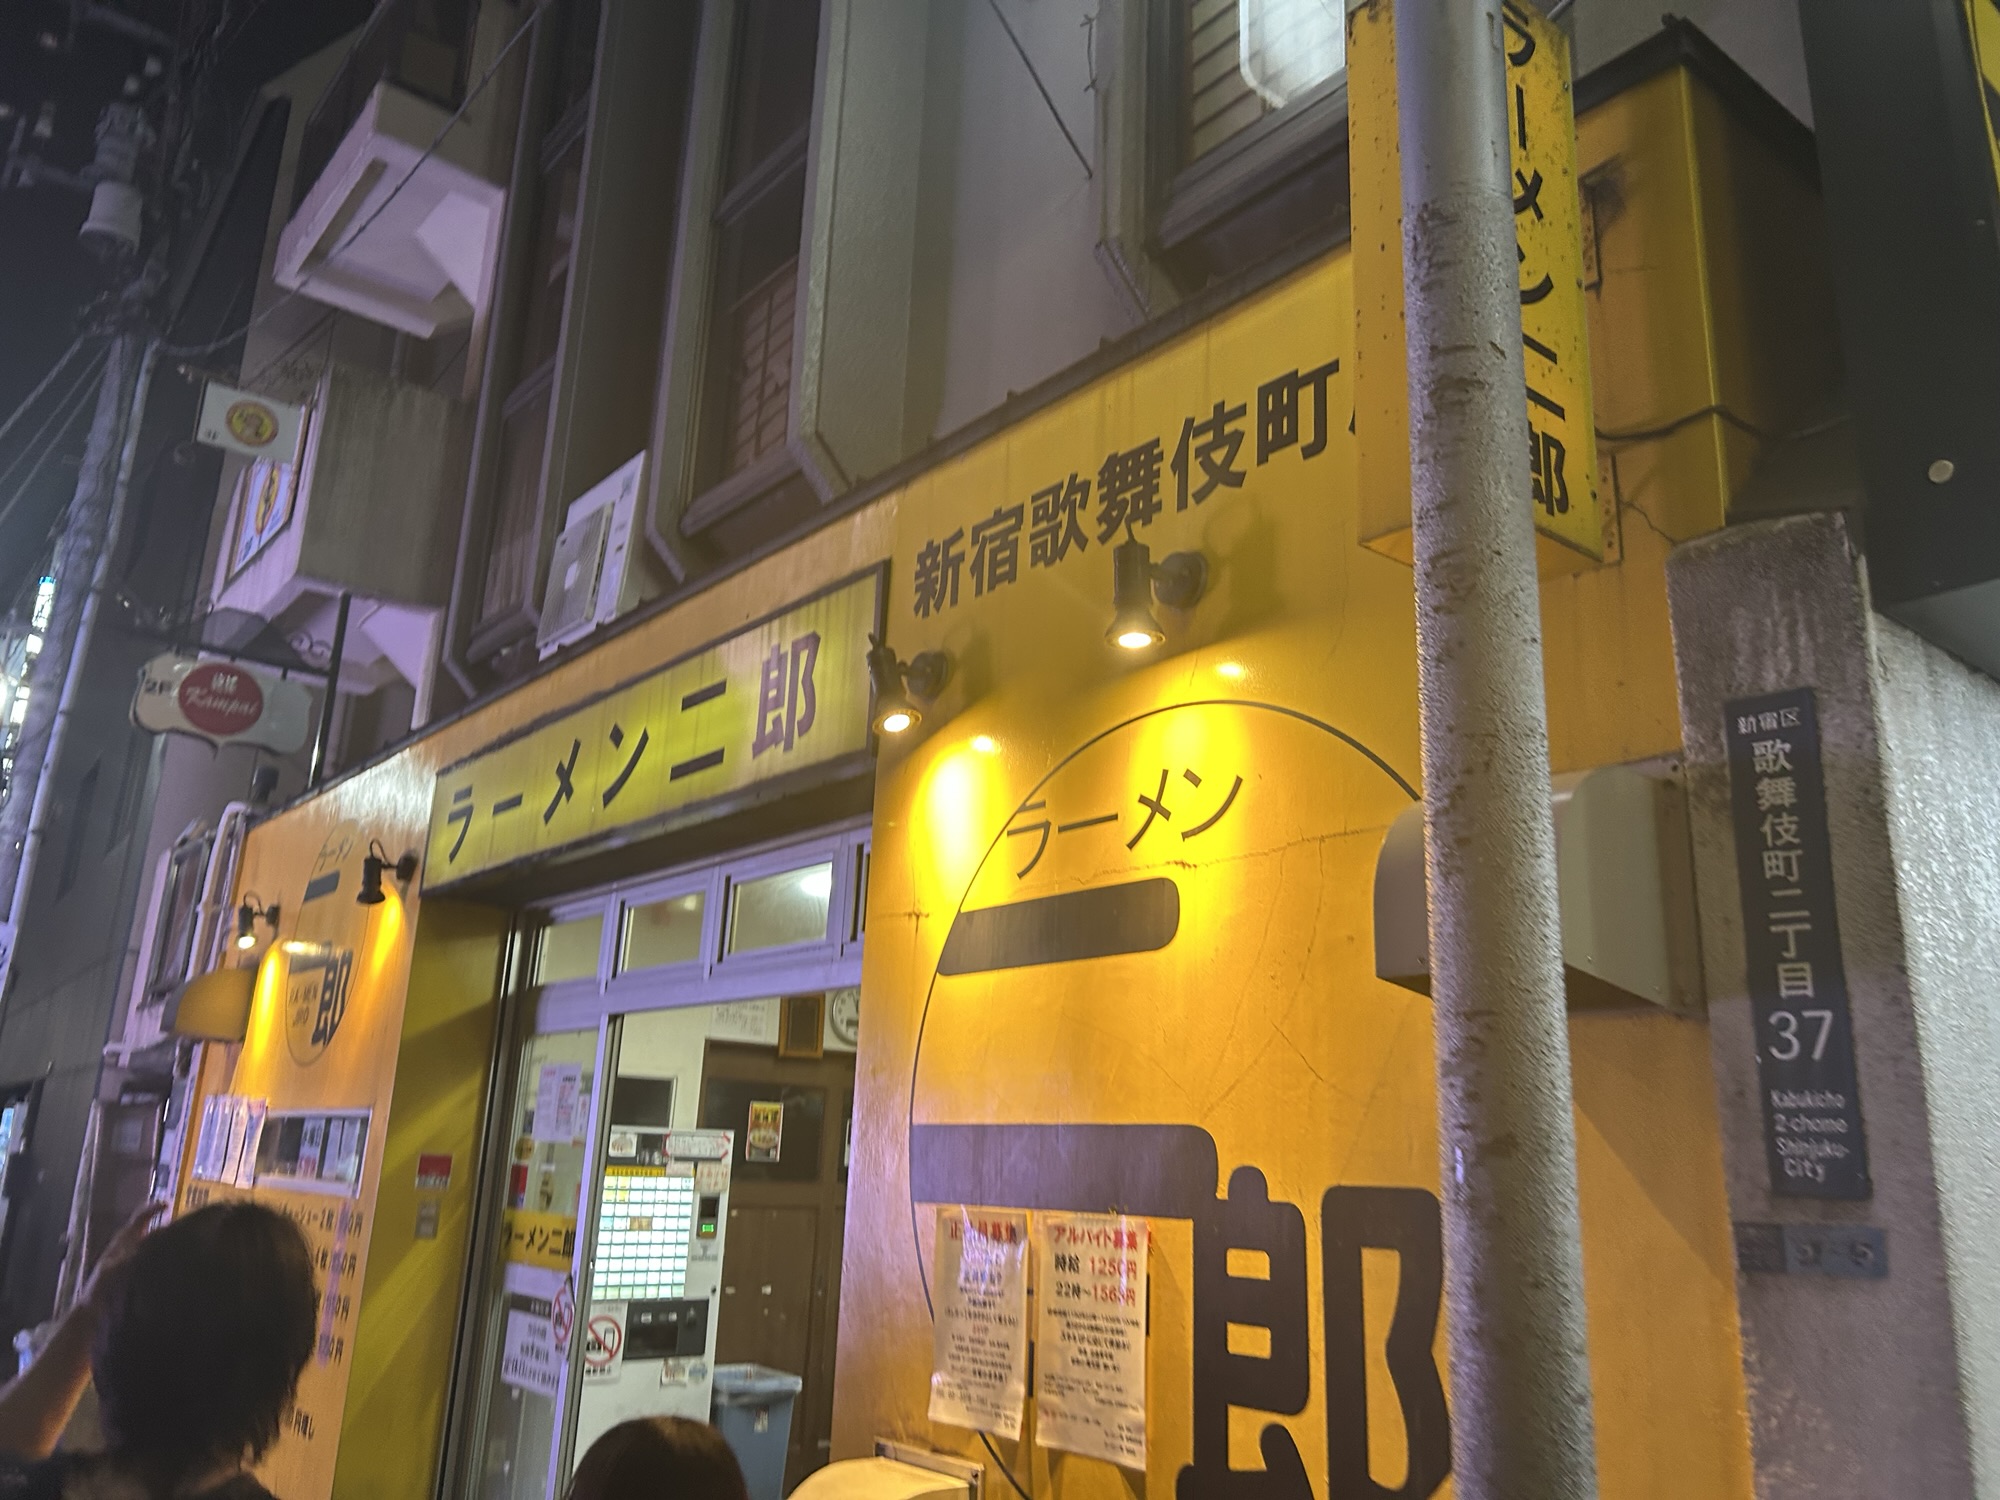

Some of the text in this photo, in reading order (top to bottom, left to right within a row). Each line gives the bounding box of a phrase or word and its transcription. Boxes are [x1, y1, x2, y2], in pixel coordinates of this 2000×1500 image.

[912, 357, 1356, 620] 新宿歌舞伎町
[446, 630, 822, 865] ラーメン二郎
[1736, 706, 1801, 736] 新宿区
[1006, 768, 1243, 880] ラーメン
[1750, 738, 1815, 999] 歌舞伎町二丁目
[1768, 1010, 1834, 1062] 37
